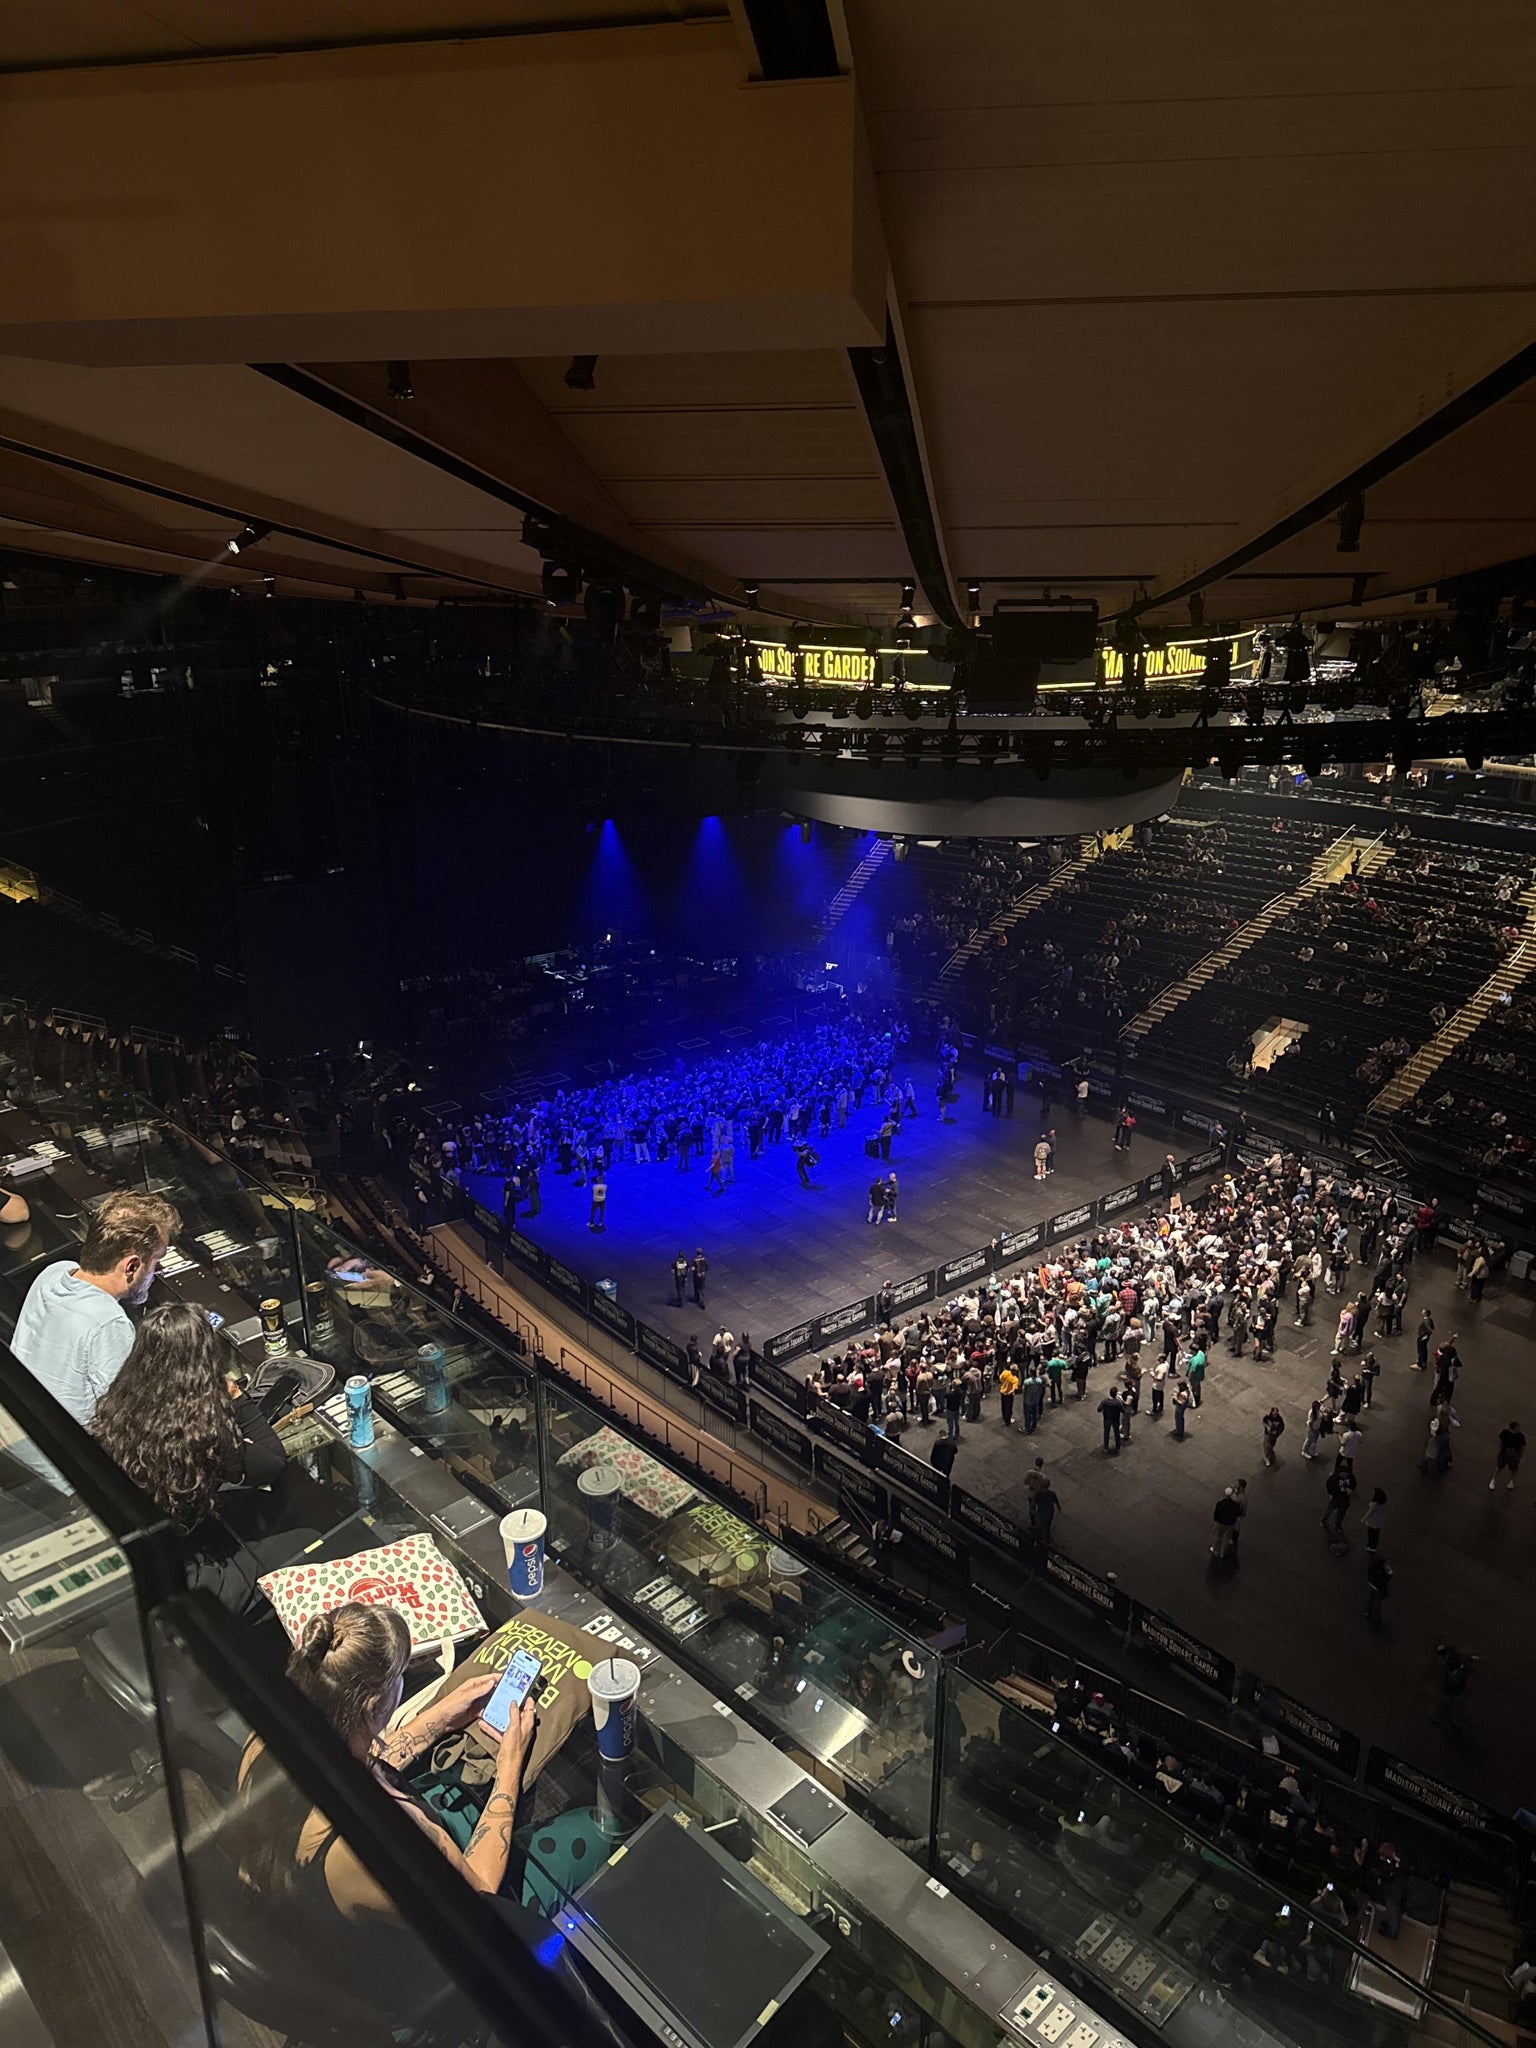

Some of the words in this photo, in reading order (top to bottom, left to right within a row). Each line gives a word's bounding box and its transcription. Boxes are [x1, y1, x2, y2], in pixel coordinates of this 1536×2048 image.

[527, 1557, 538, 1586] pepsi
[1046, 1559, 1070, 1582] MADISON
[1070, 1575, 1092, 1596] SQUARE
[1092, 1588, 1114, 1609] GARDEN
[507, 1620, 583, 1669] MEMBER
[1141, 1620, 1169, 1646] MADISON
[1168, 1639, 1193, 1660] SQUARE
[1193, 1655, 1219, 1679] GARDEN
[1311, 1728, 1340, 1752] GARDEN
[1384, 1768, 1420, 1794] MADISON
[1421, 1788, 1452, 1813] SQUARE
[1453, 1805, 1487, 1829] GARDEN
[934, 1884, 942, 1892] 5
